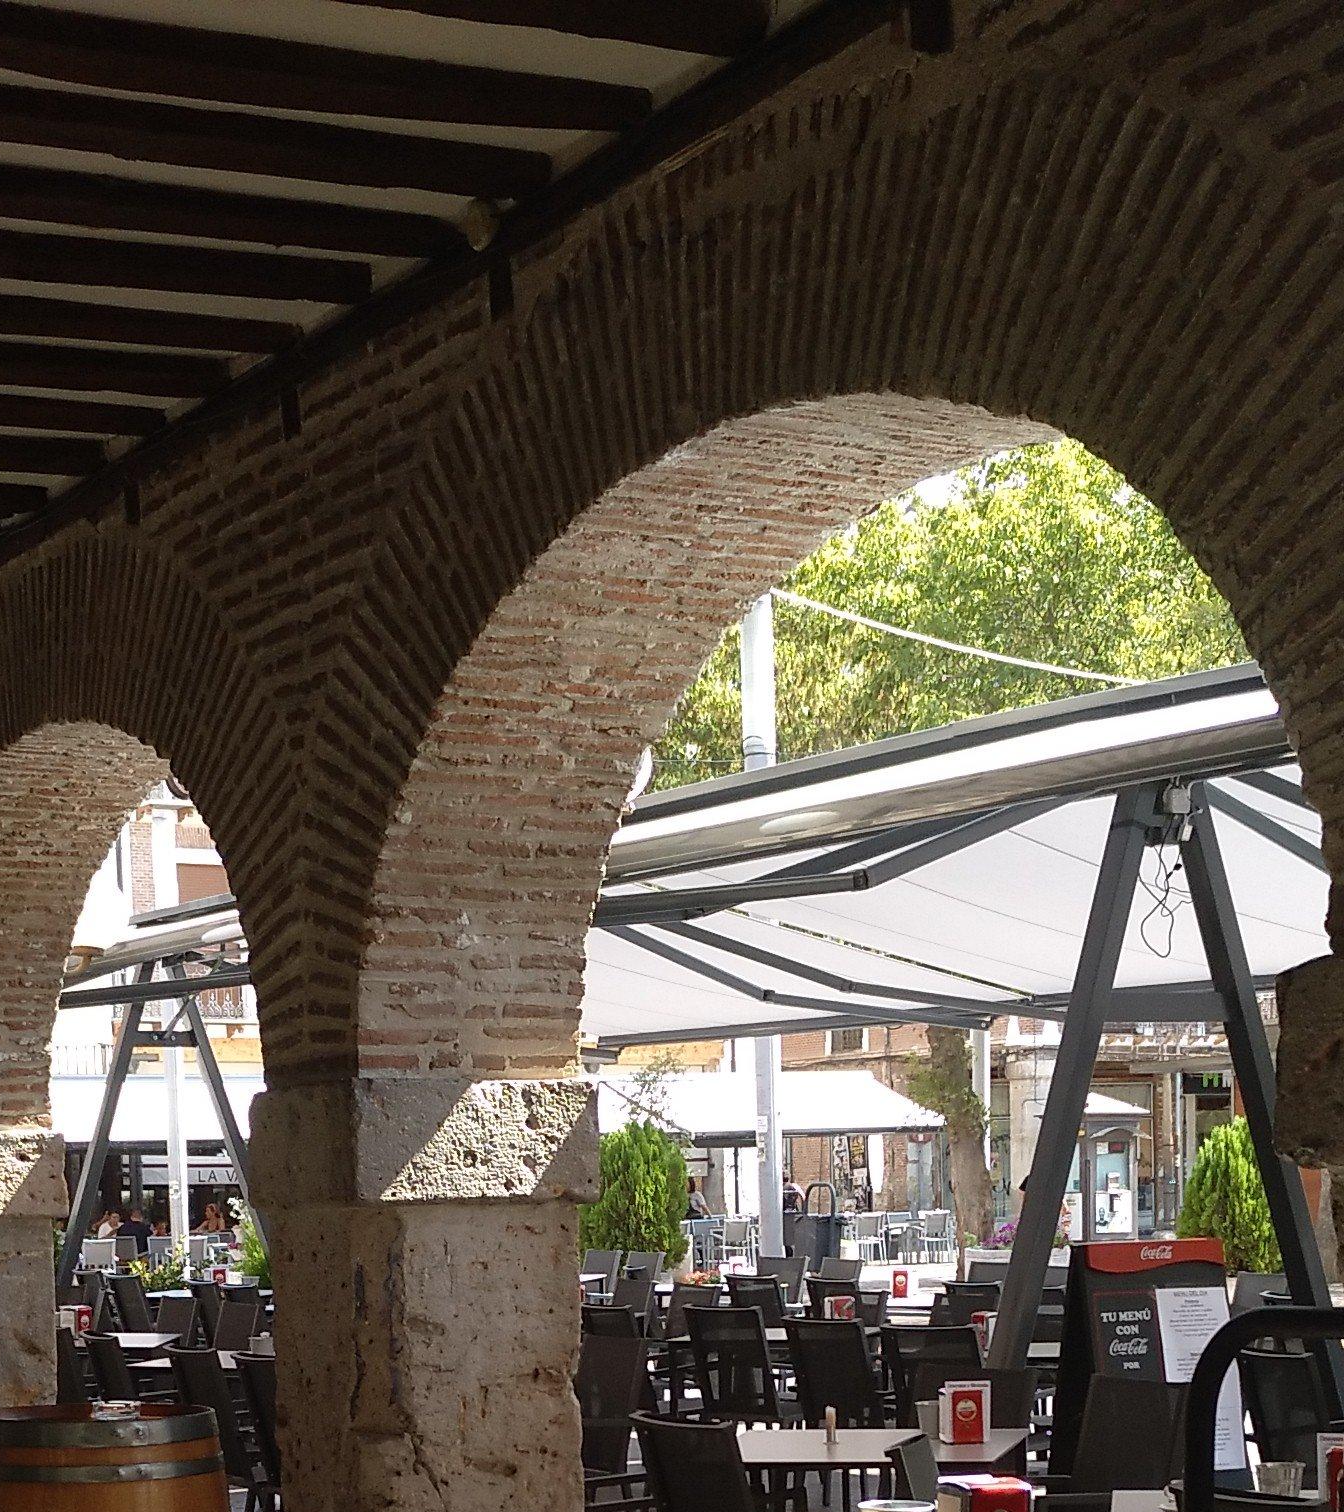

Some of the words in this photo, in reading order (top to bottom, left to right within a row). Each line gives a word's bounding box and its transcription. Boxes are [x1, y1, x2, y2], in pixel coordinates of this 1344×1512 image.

[198, 1170, 218, 1183] LA
[1140, 1245, 1174, 1260] Coca-Cola
[1100, 1312, 1117, 1323] TU
[1118, 1307, 1152, 1322] MENÚ
[1115, 1325, 1140, 1335] CON
[1109, 1337, 1149, 1356] Coca-Cola
[1123, 1361, 1141, 1370] POR
